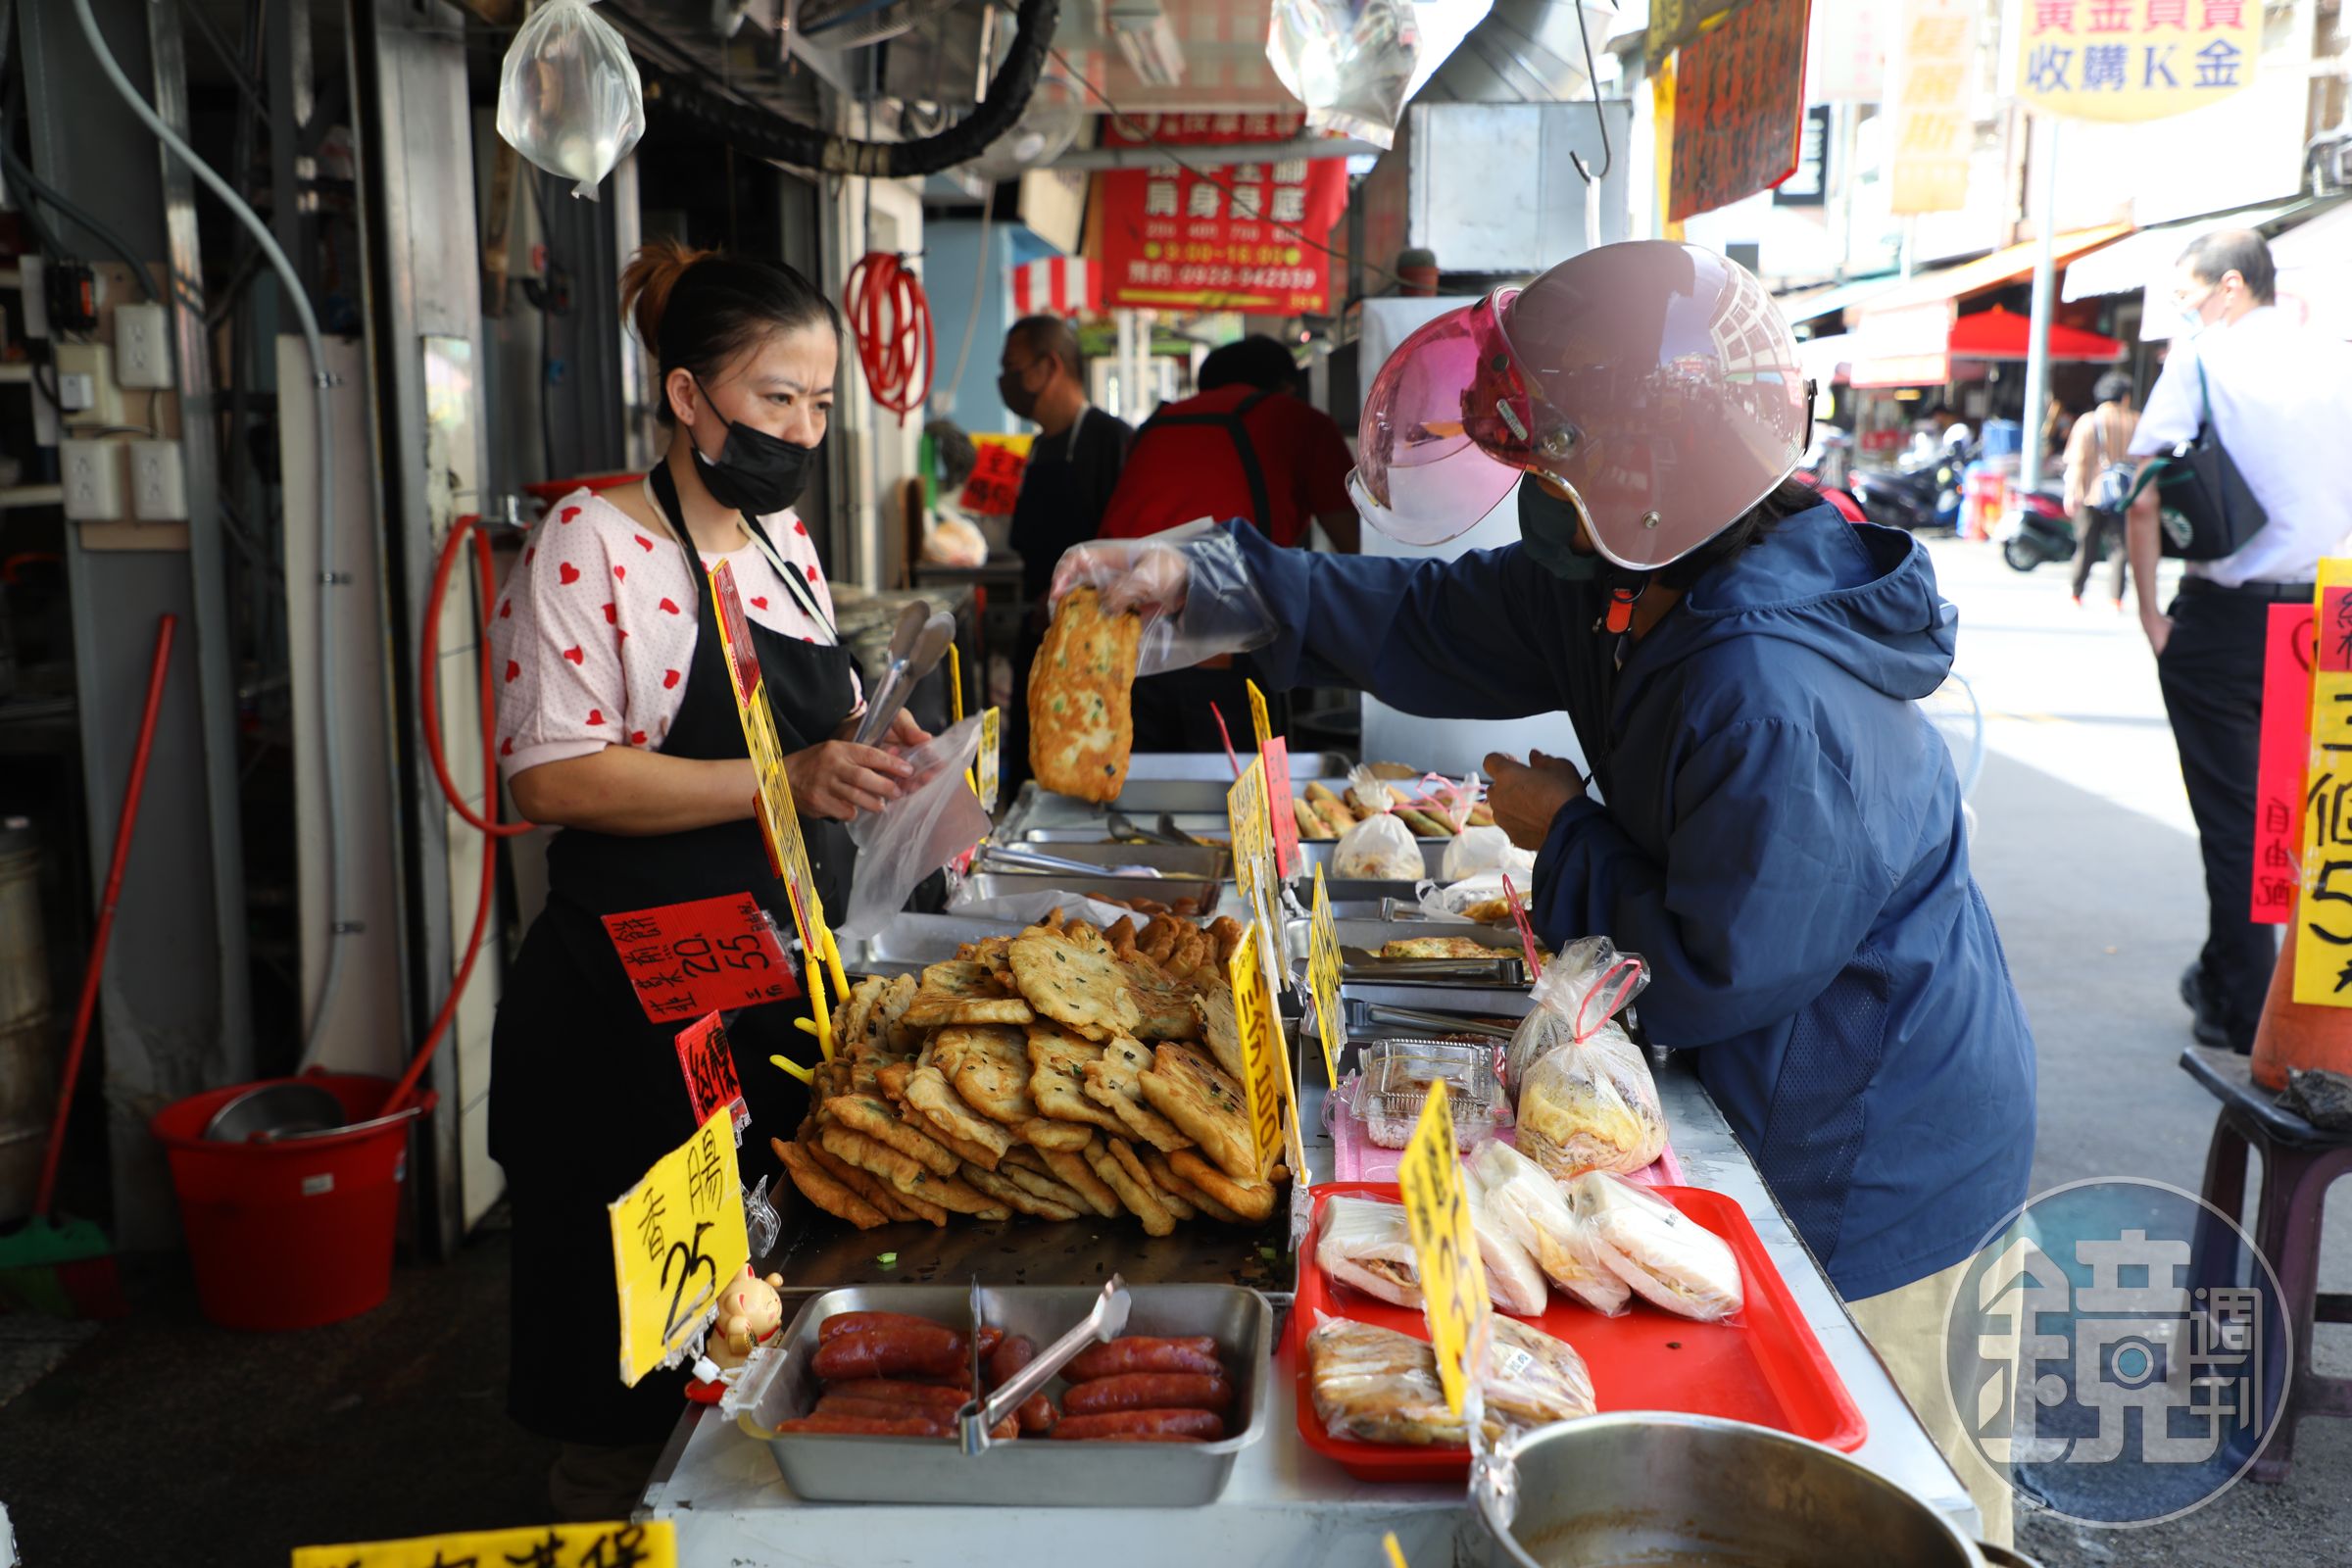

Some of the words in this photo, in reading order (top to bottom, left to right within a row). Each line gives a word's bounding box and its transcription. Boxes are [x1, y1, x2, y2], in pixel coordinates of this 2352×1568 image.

[2026, 38, 2242, 93] 收購K金
[638, 1128, 722, 1262] 香腸
[660, 1221, 717, 1348] 25
